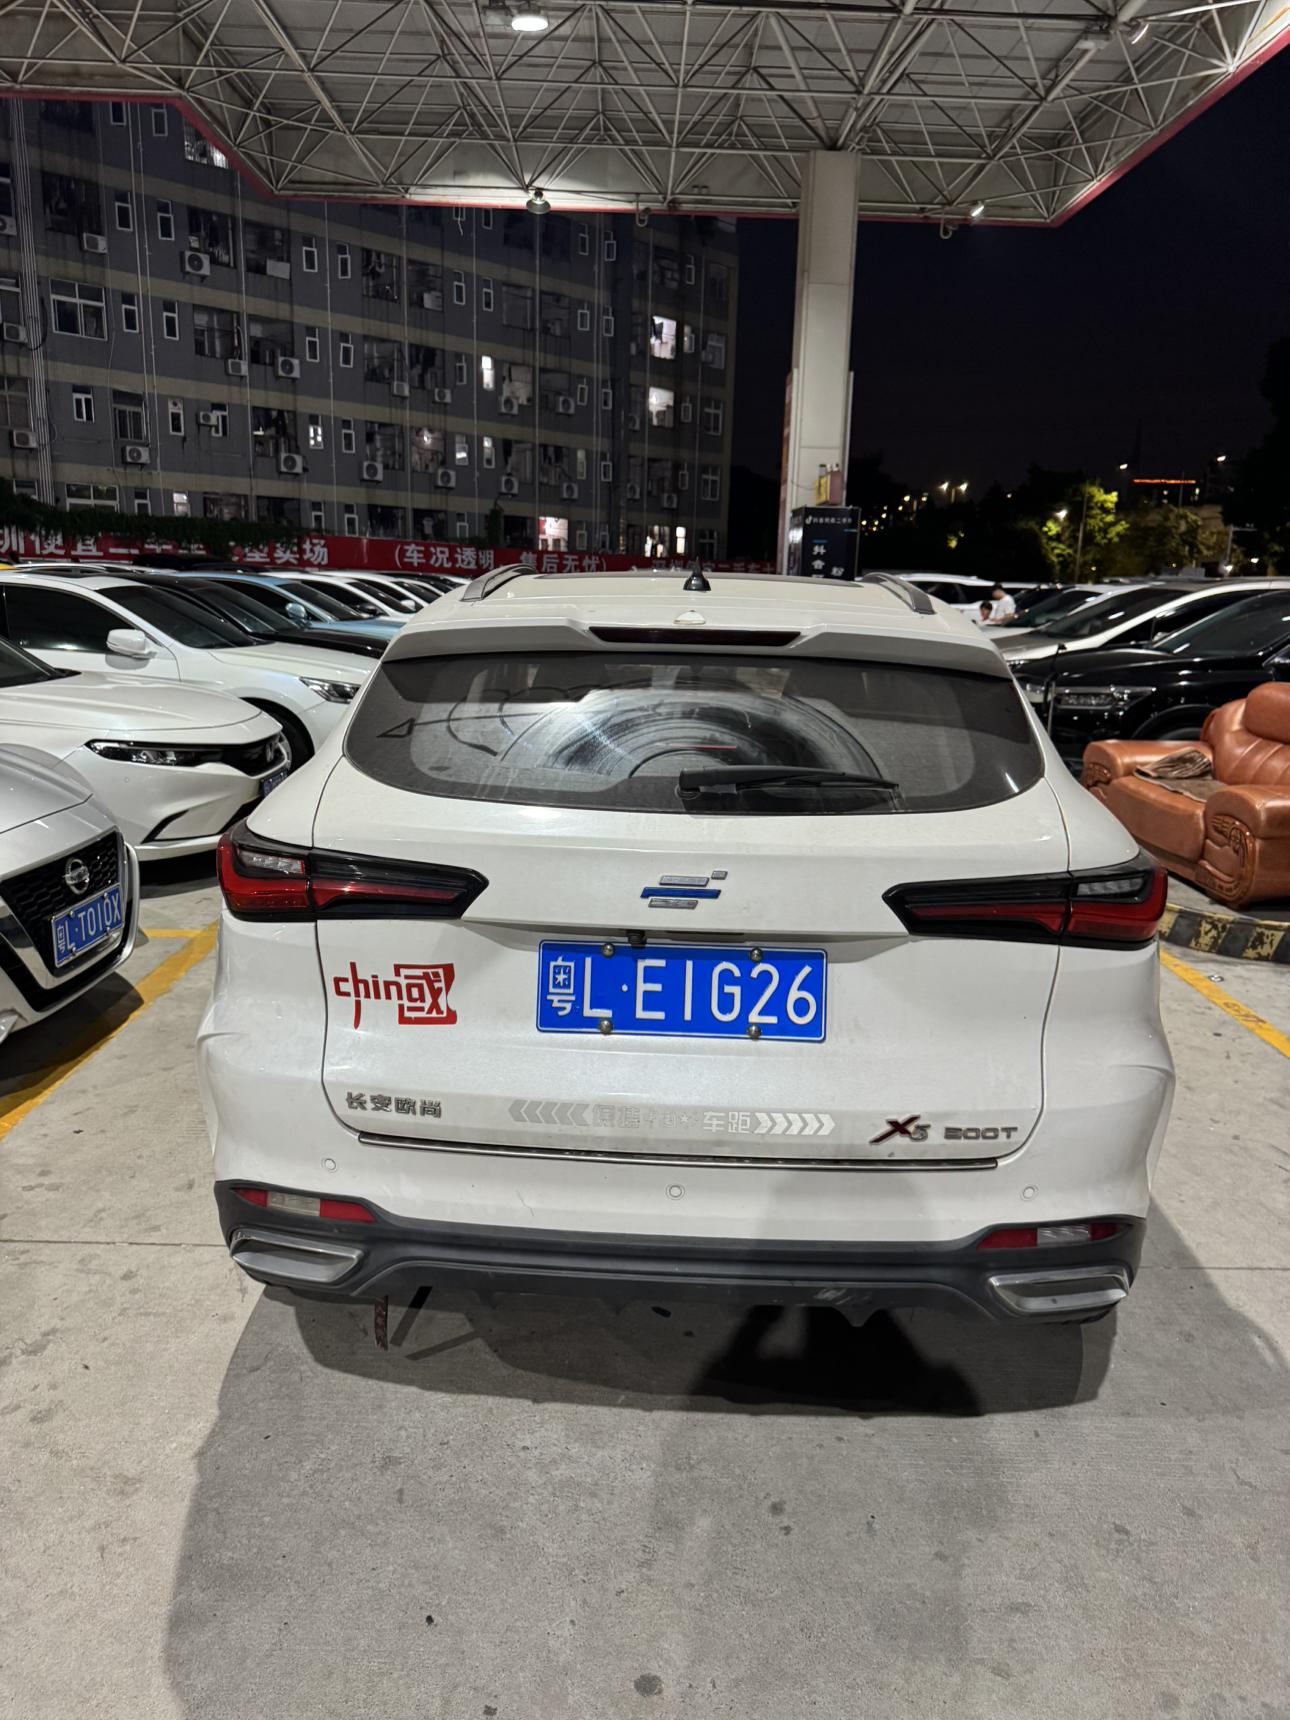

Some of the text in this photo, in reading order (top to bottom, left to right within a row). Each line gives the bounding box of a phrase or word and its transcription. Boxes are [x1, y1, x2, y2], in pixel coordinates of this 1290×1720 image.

[546, 956, 818, 1025] 粤L·E1G26
[346, 1091, 443, 1119] 长安欧尚
[869, 1112, 932, 1145] X5
